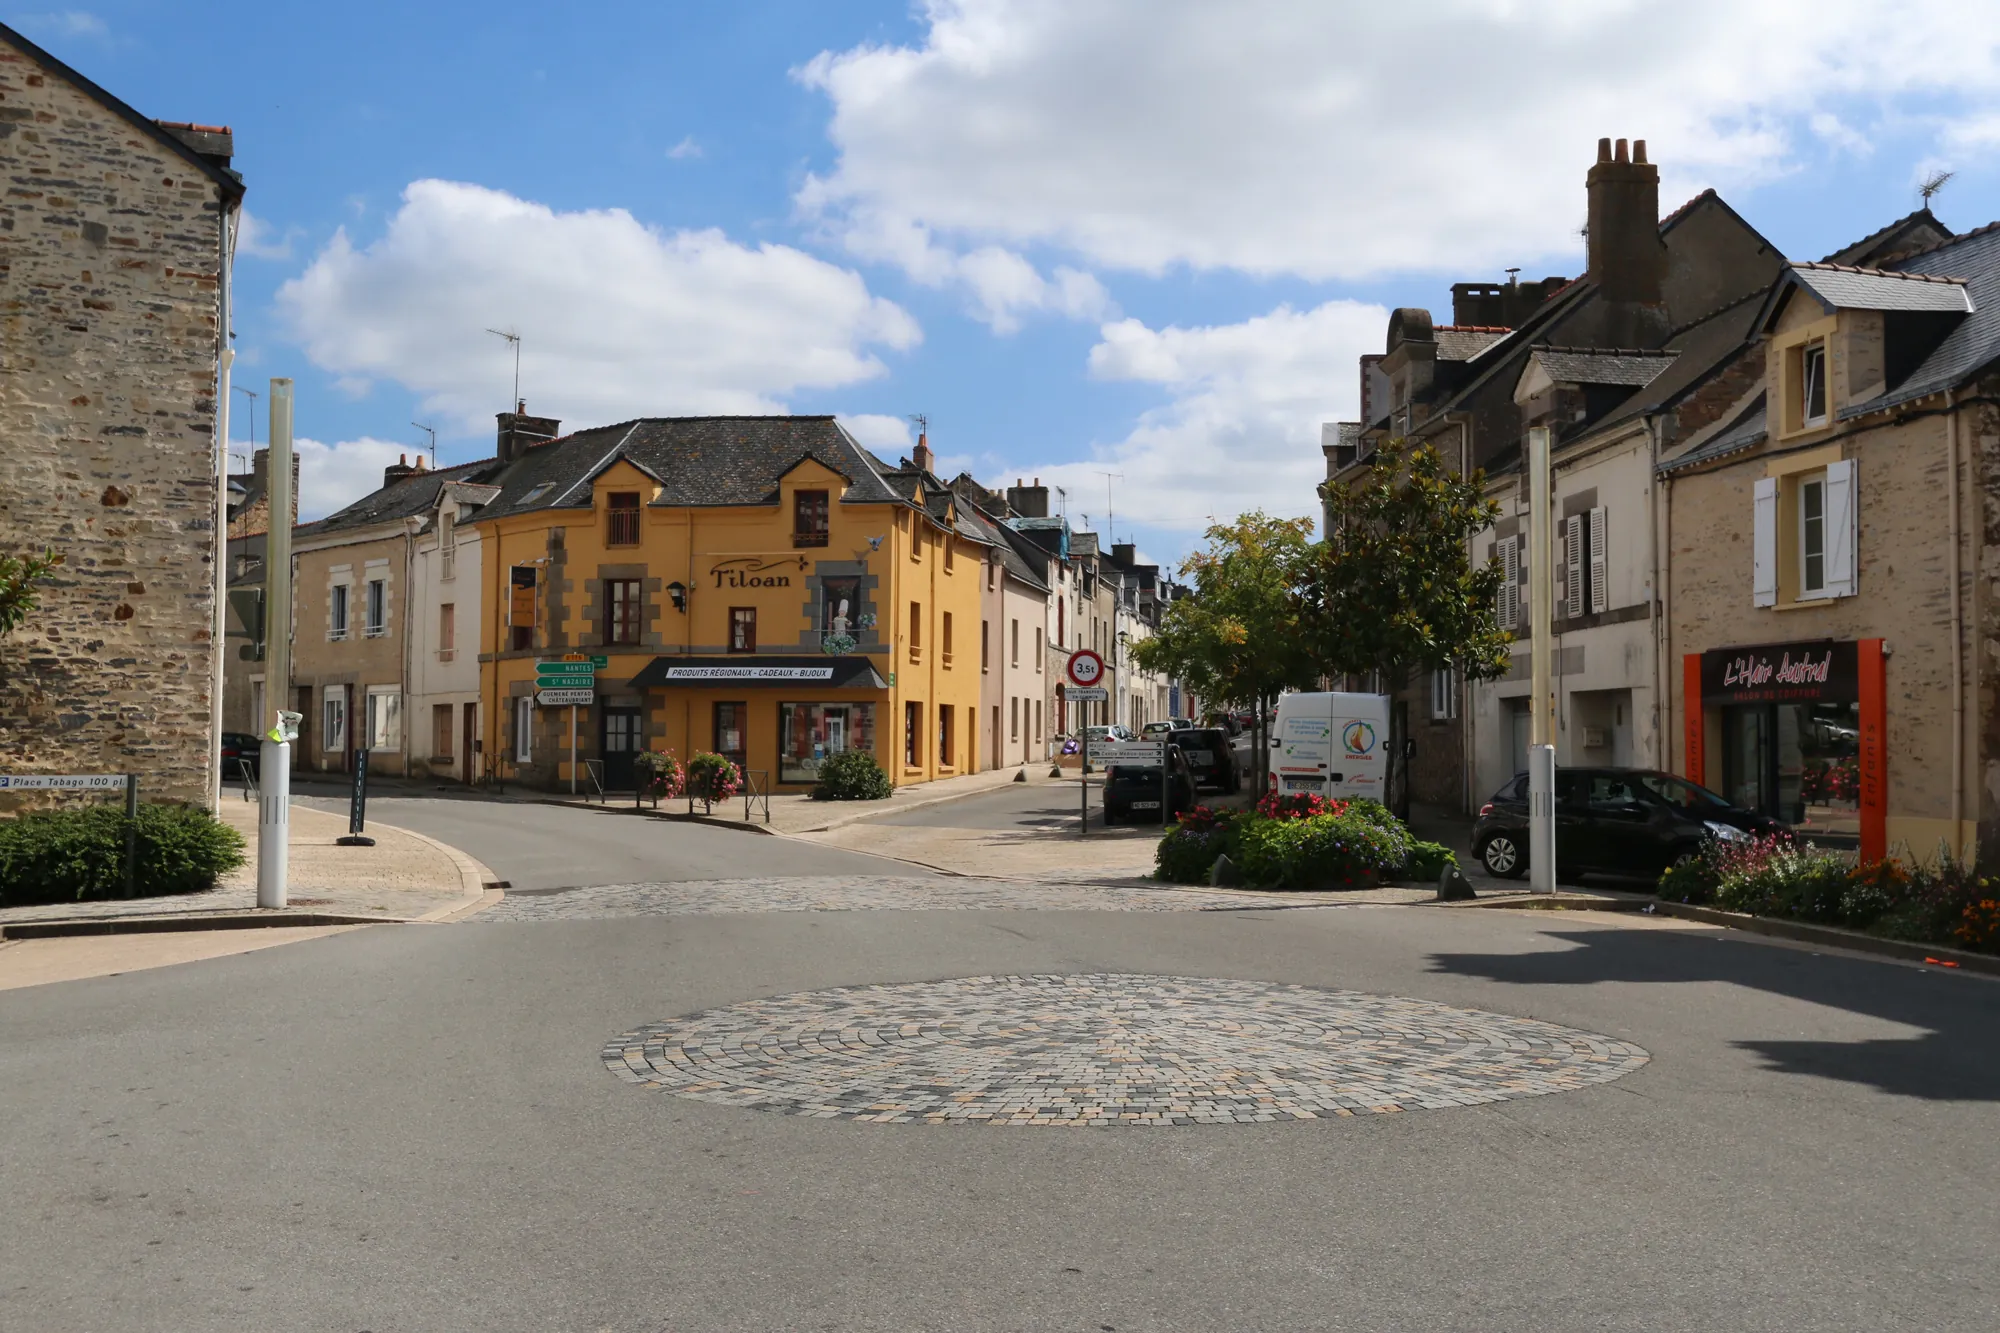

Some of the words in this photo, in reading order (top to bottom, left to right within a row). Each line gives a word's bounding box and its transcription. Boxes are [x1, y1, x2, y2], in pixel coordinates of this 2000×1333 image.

[710, 568, 790, 588] Tiloan
[671, 669, 709, 677] PRODUITS
[710, 668, 752, 677] RÉGIONAUX
[758, 669, 794, 677] CADEAUX
[800, 669, 828, 677] BIJOUX
[1077, 663, 1095, 675] 3,5t
[1723, 654, 1773, 688] L'Hair
[1776, 650, 1832, 684] Austral
[1864, 723, 1878, 808] Enfants
[13, 778, 42, 787] Place
[49, 778, 84, 788] Tabago
[89, 778, 108, 786] 100
